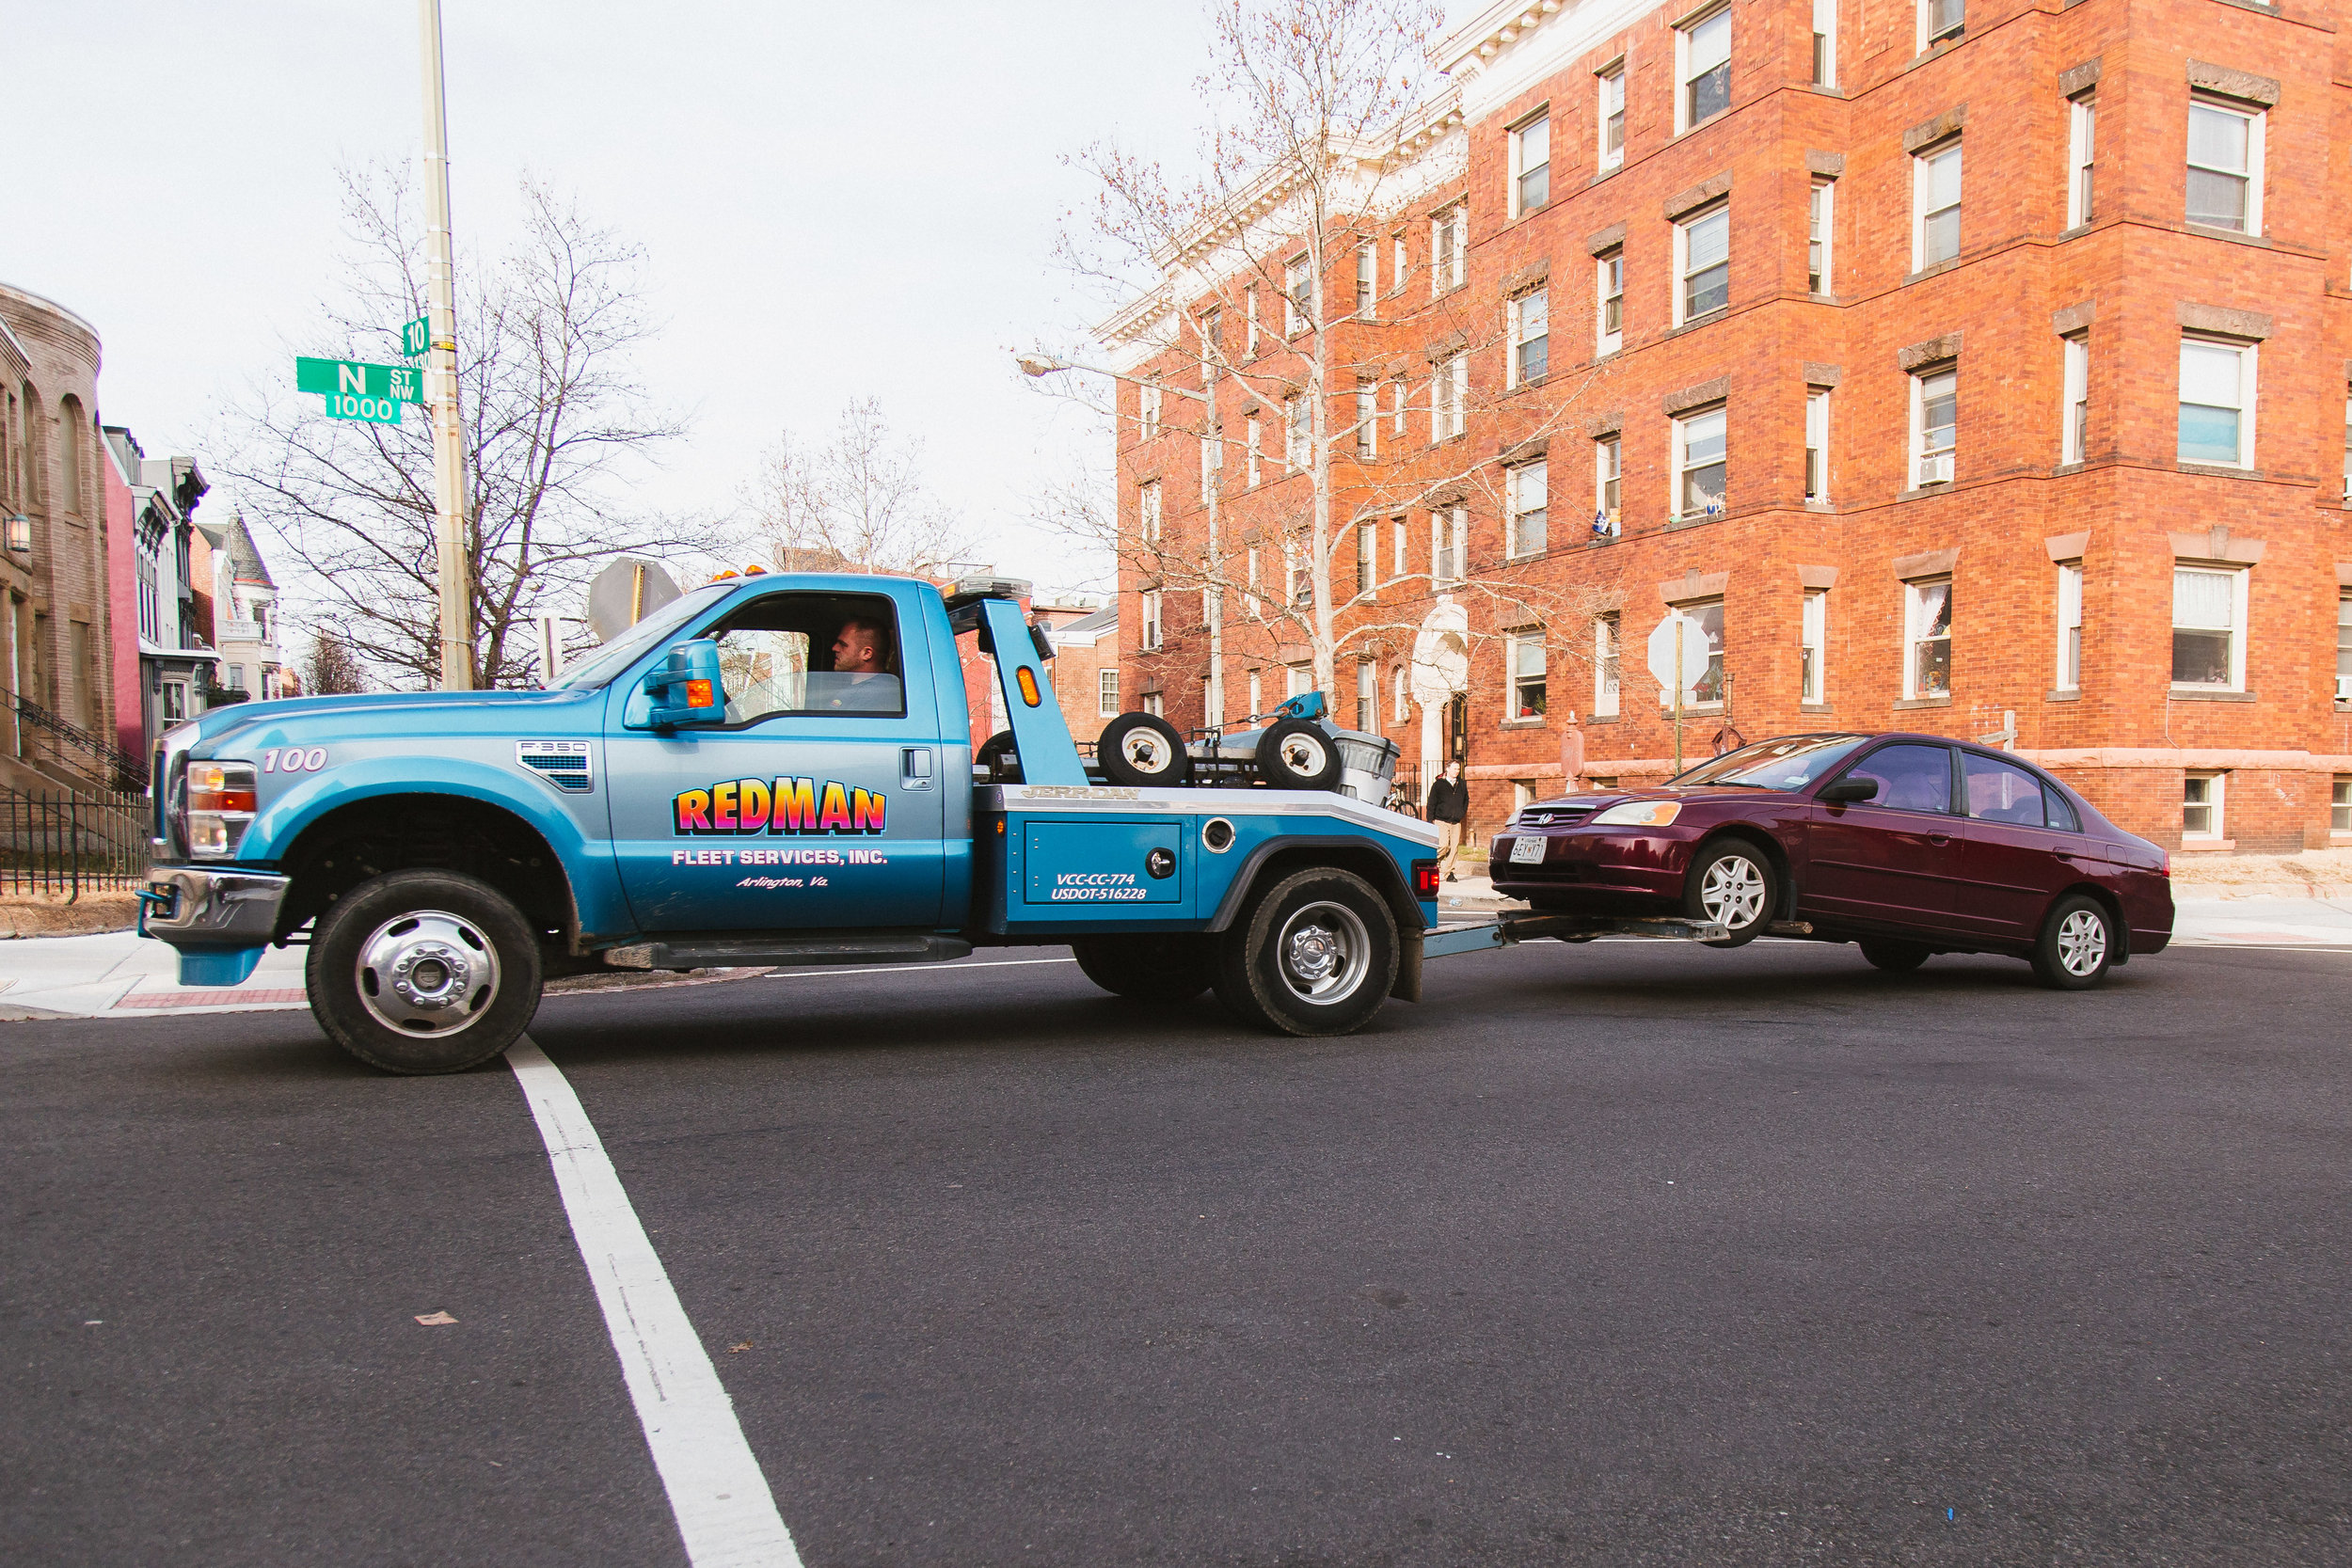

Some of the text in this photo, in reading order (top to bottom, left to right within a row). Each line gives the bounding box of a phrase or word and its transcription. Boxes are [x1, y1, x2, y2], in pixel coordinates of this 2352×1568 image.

[407, 321, 425, 353] 10
[339, 364, 367, 394] N
[389, 369, 413, 385] ST
[389, 384, 415, 401] NW
[333, 395, 393, 420] 1000
[263, 747, 328, 774] 100
[671, 775, 889, 837] REDMAN
[672, 848, 889, 866] FLEET SERVICES, INC.
[736, 876, 829, 890] Arlington, Va.
[1057, 873, 1136, 886] VCC-CC-774
[1051, 887, 1147, 900] USDOT-516228
